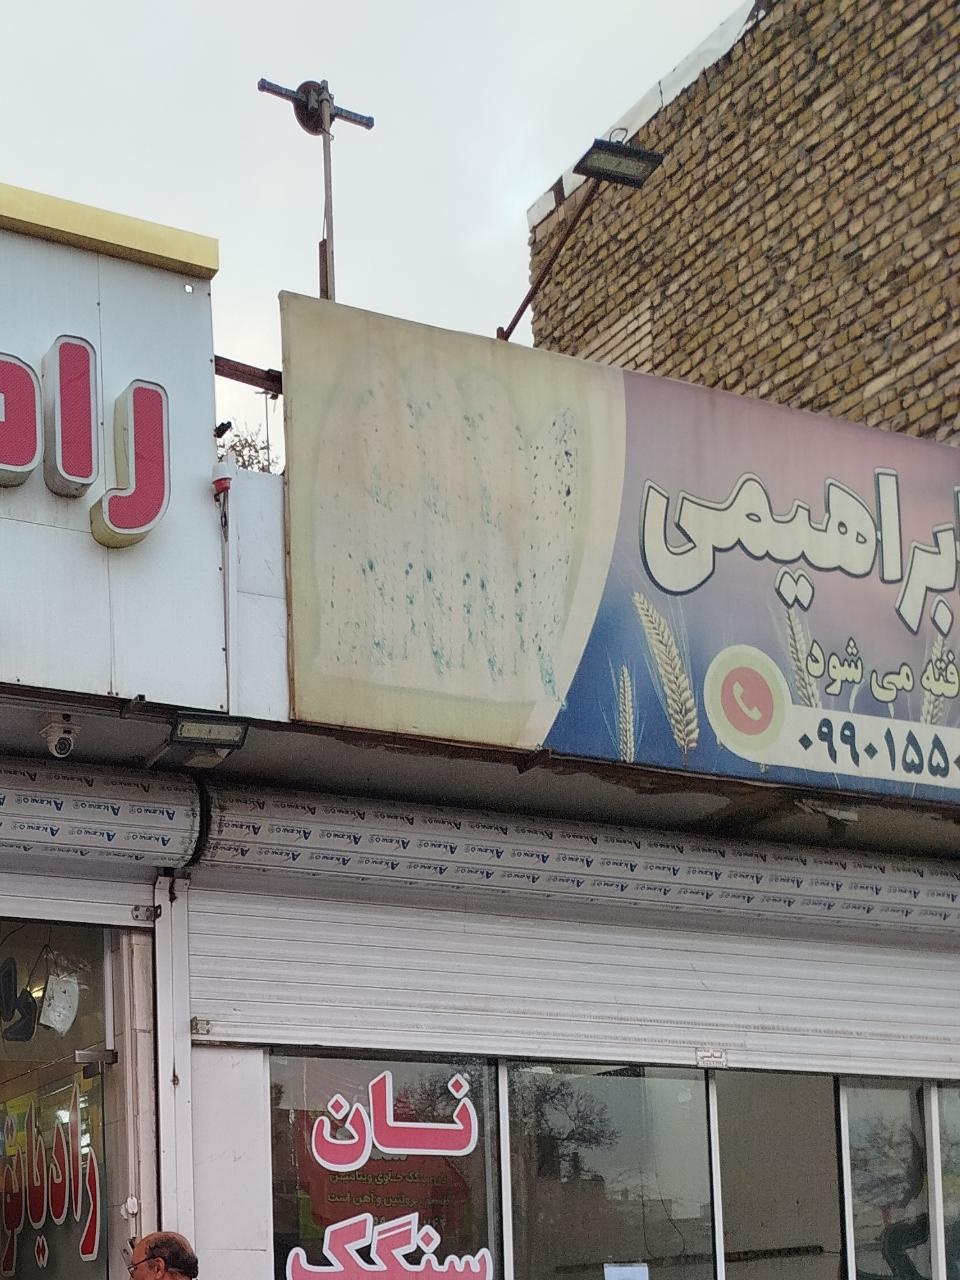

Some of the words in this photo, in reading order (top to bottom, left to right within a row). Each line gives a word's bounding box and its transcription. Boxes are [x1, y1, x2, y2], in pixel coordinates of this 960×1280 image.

[642, 466, 960, 636] براهیمی
[806, 637, 863, 696] شود
[870, 662, 914, 703] می
[312, 1071, 478, 1172] نان
